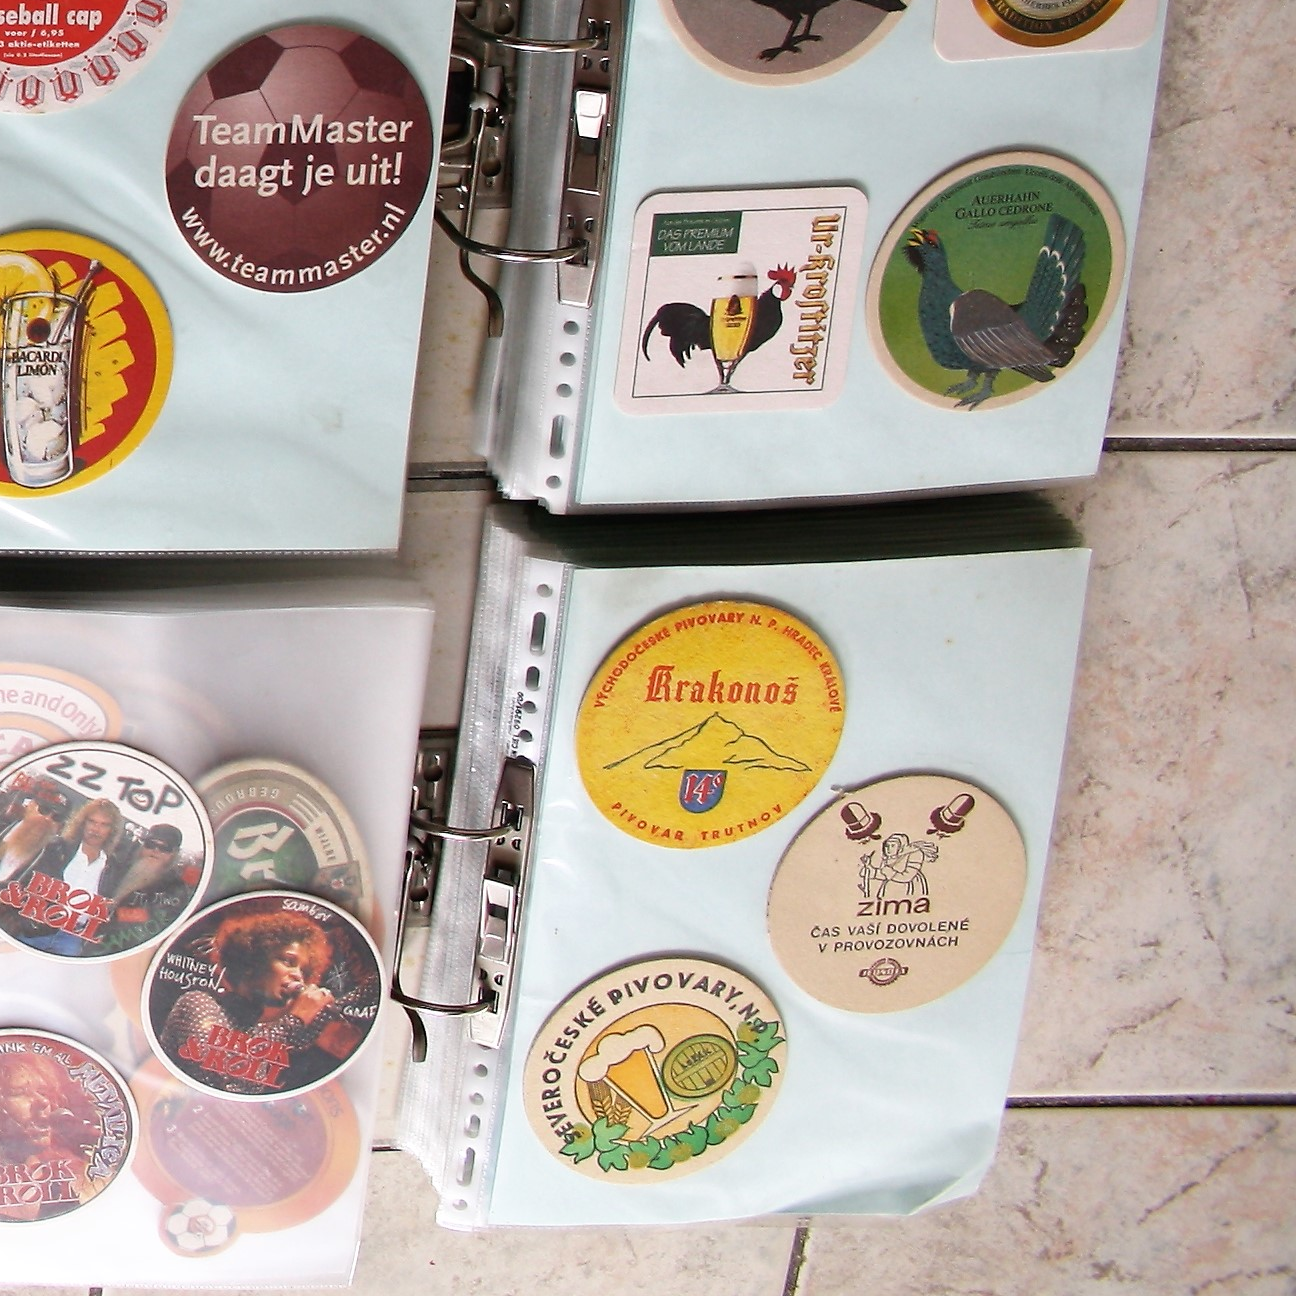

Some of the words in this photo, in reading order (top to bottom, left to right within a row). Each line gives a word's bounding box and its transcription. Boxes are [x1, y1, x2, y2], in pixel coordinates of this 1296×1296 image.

[66, 7, 102, 31] cap
[193, 114, 413, 146] TeamMaster
[194, 155, 294, 198] daagt
[301, 155, 335, 196] je
[346, 152, 403, 186] uit!
[955, 206, 996, 220] GALLO
[998, 202, 1054, 216] CEDRONE
[972, 191, 1040, 206] AUERHAHN
[182, 202, 406, 285] www.teammaster.nl
[11, 351, 63, 364] BACARDI
[16, 362, 57, 376] LIMÓN
[644, 664, 800, 705] Krakonoš
[22, 690, 60, 713] and
[59, 701, 104, 736] Only
[45, 755, 108, 791] ZZ
[116, 776, 183, 815] TOP
[612, 802, 684, 841] PIVOVAR
[700, 804, 783, 841] TRUTNOV
[857, 896, 930, 918] zima
[810, 924, 841, 938] ČAS
[848, 923, 881, 936] VAŠÍ
[886, 917, 970, 934] DOVOLENÉ
[818, 943, 828, 953] V
[834, 935, 959, 952] PROVOZOVNÁCH
[167, 952, 218, 976] WHITNEY
[607, 971, 740, 1011] PIVOVARY,
[70, 1062, 127, 1182] METALLICA
